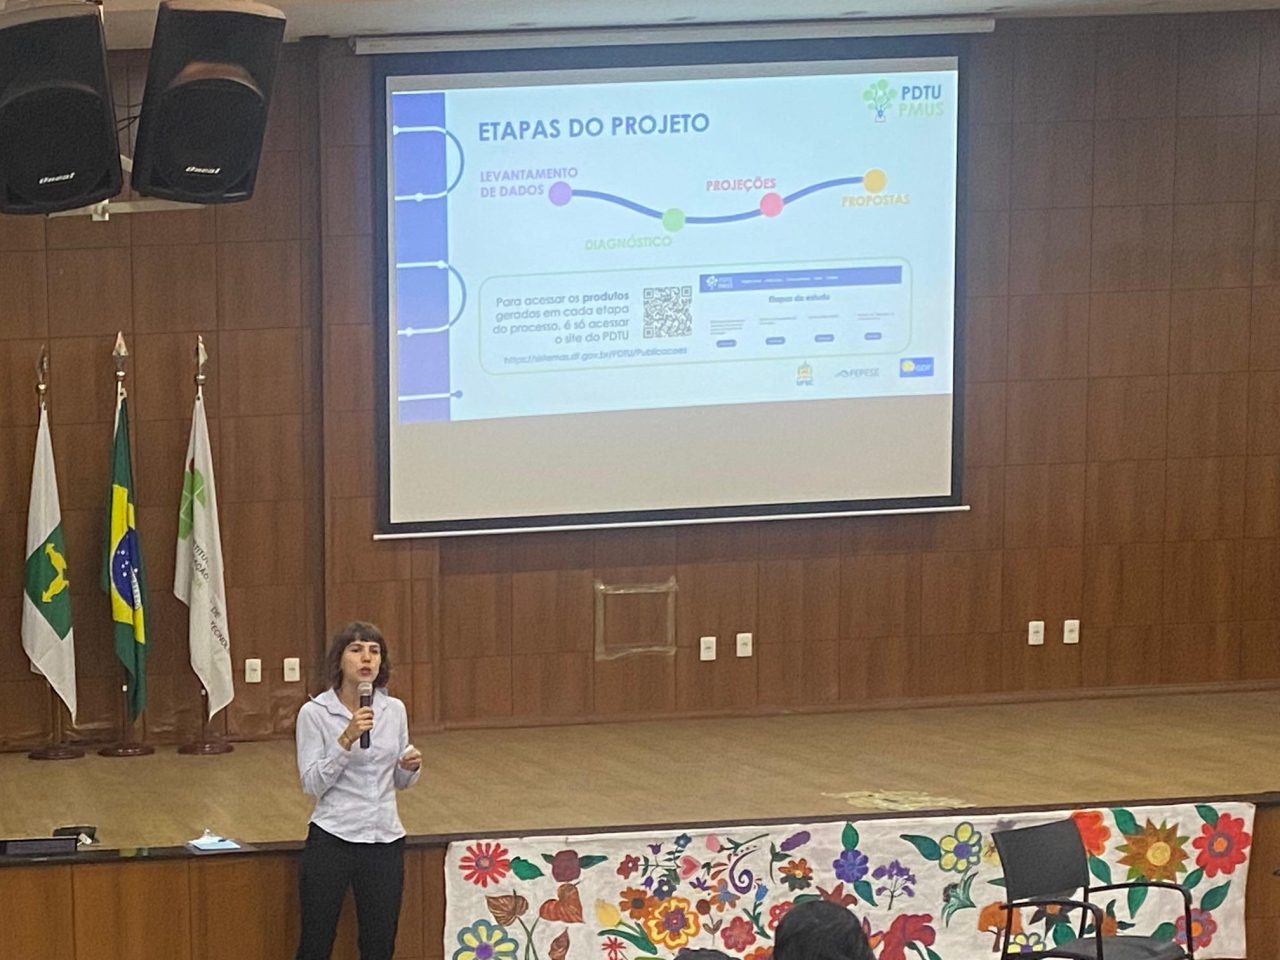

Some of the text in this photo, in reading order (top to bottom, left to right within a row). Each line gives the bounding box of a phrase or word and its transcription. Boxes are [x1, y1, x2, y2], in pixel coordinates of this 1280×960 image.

[901, 84, 942, 100] PDTU
[478, 112, 710, 142] ETAPAS DO PROJETO
[480, 167, 578, 182] LEVANTAMENTO
[480, 184, 545, 198] DE DADOS
[706, 176, 777, 192] PROJEÇÕES
[841, 194, 911, 208] PROPOSTAS
[585, 234, 673, 251] DIAGNÓSTICO
[496, 291, 629, 308] Para acessar os produtos
[495, 304, 630, 323] gerados em cada etapa
[492, 324, 508, 335] do
[563, 319, 571, 330] é
[573, 319, 586, 330] só
[587, 318, 629, 329] acessar
[554, 330, 630, 345] o site do PDTU
